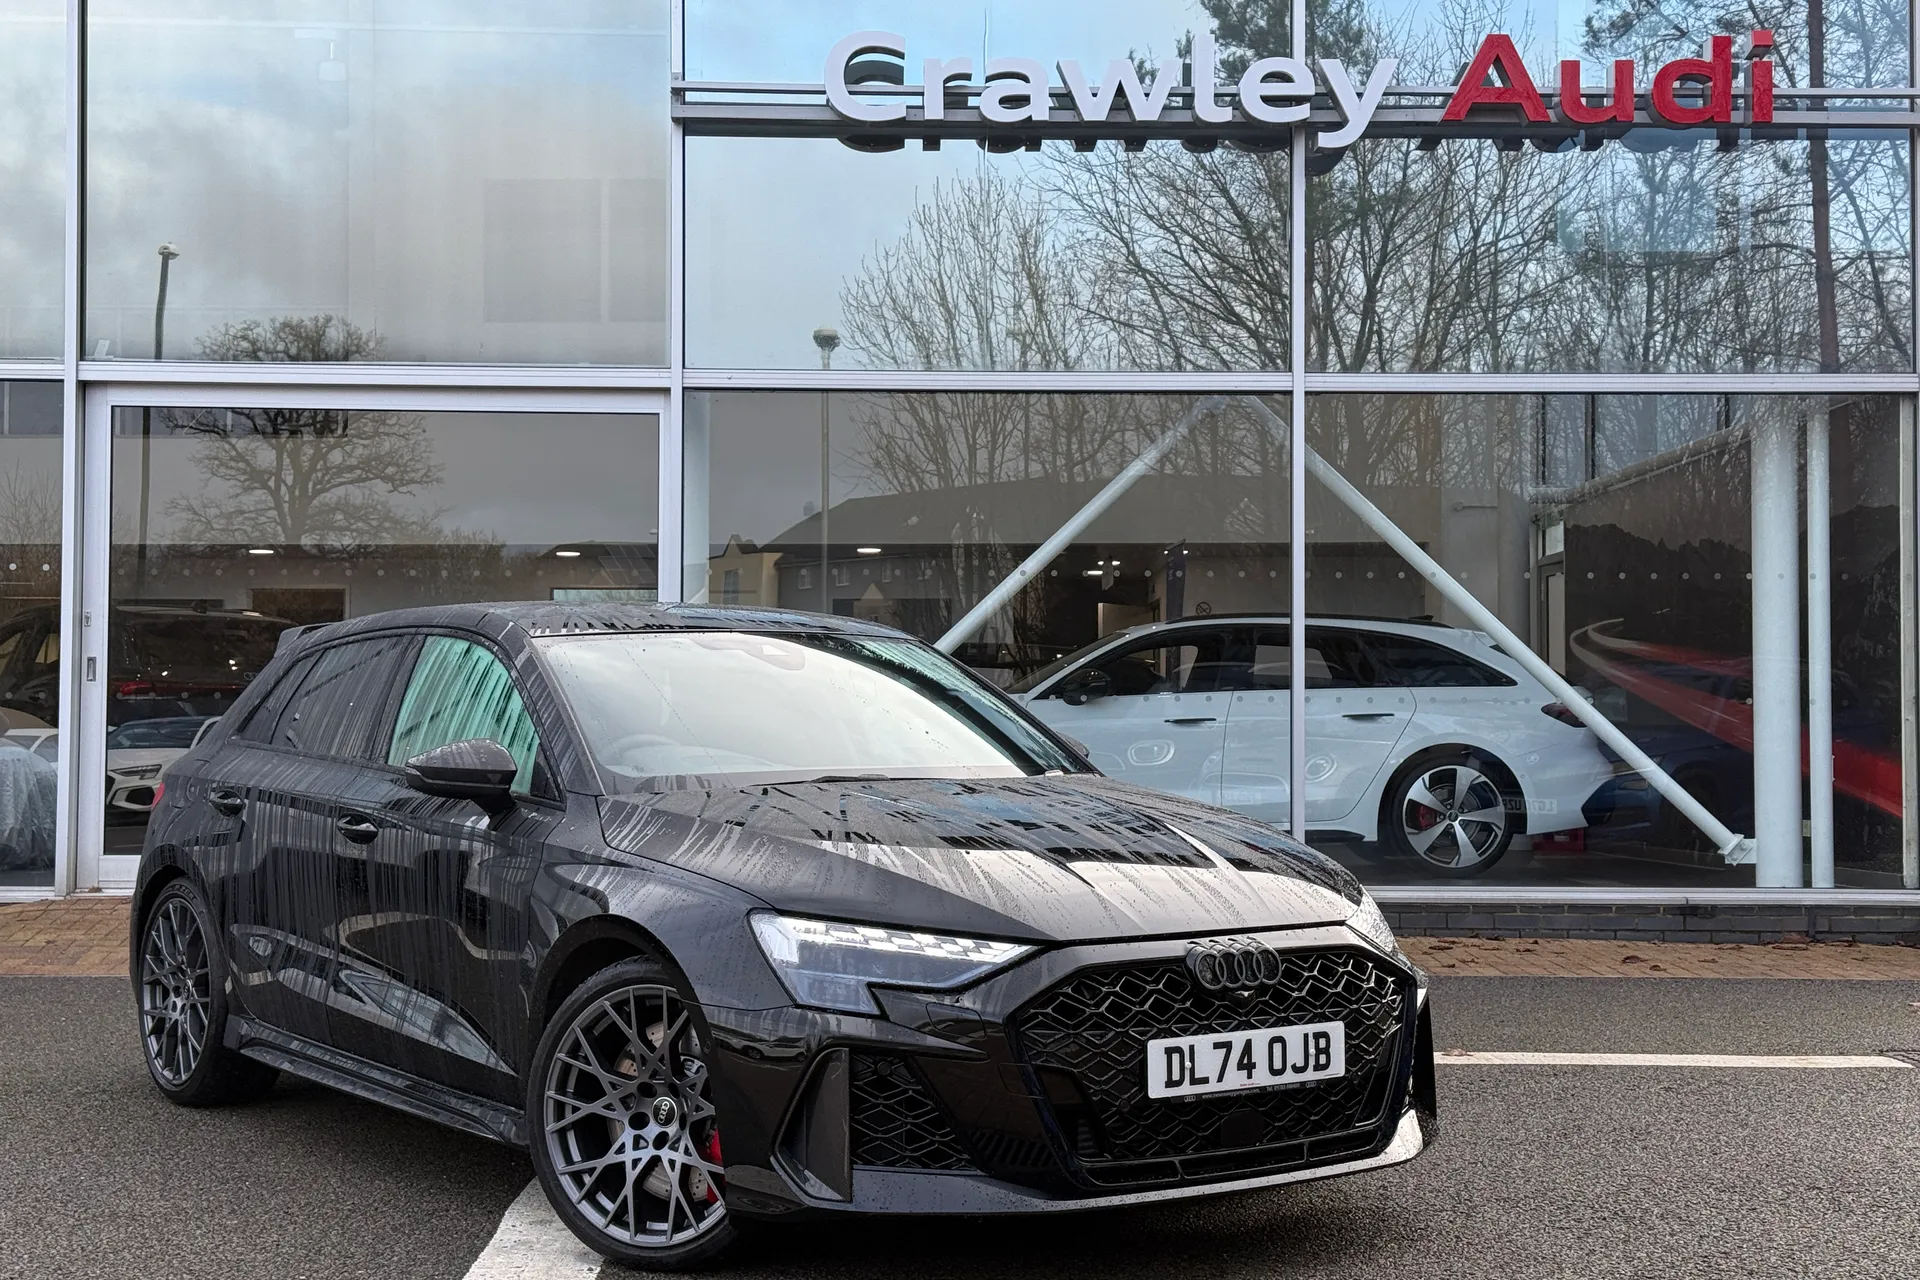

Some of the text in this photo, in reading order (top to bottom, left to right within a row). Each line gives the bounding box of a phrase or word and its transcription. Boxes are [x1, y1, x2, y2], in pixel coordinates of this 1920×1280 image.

[823, 29, 1774, 152] Crawley Audi
[1163, 1030, 1332, 1089] DL74 OJB
